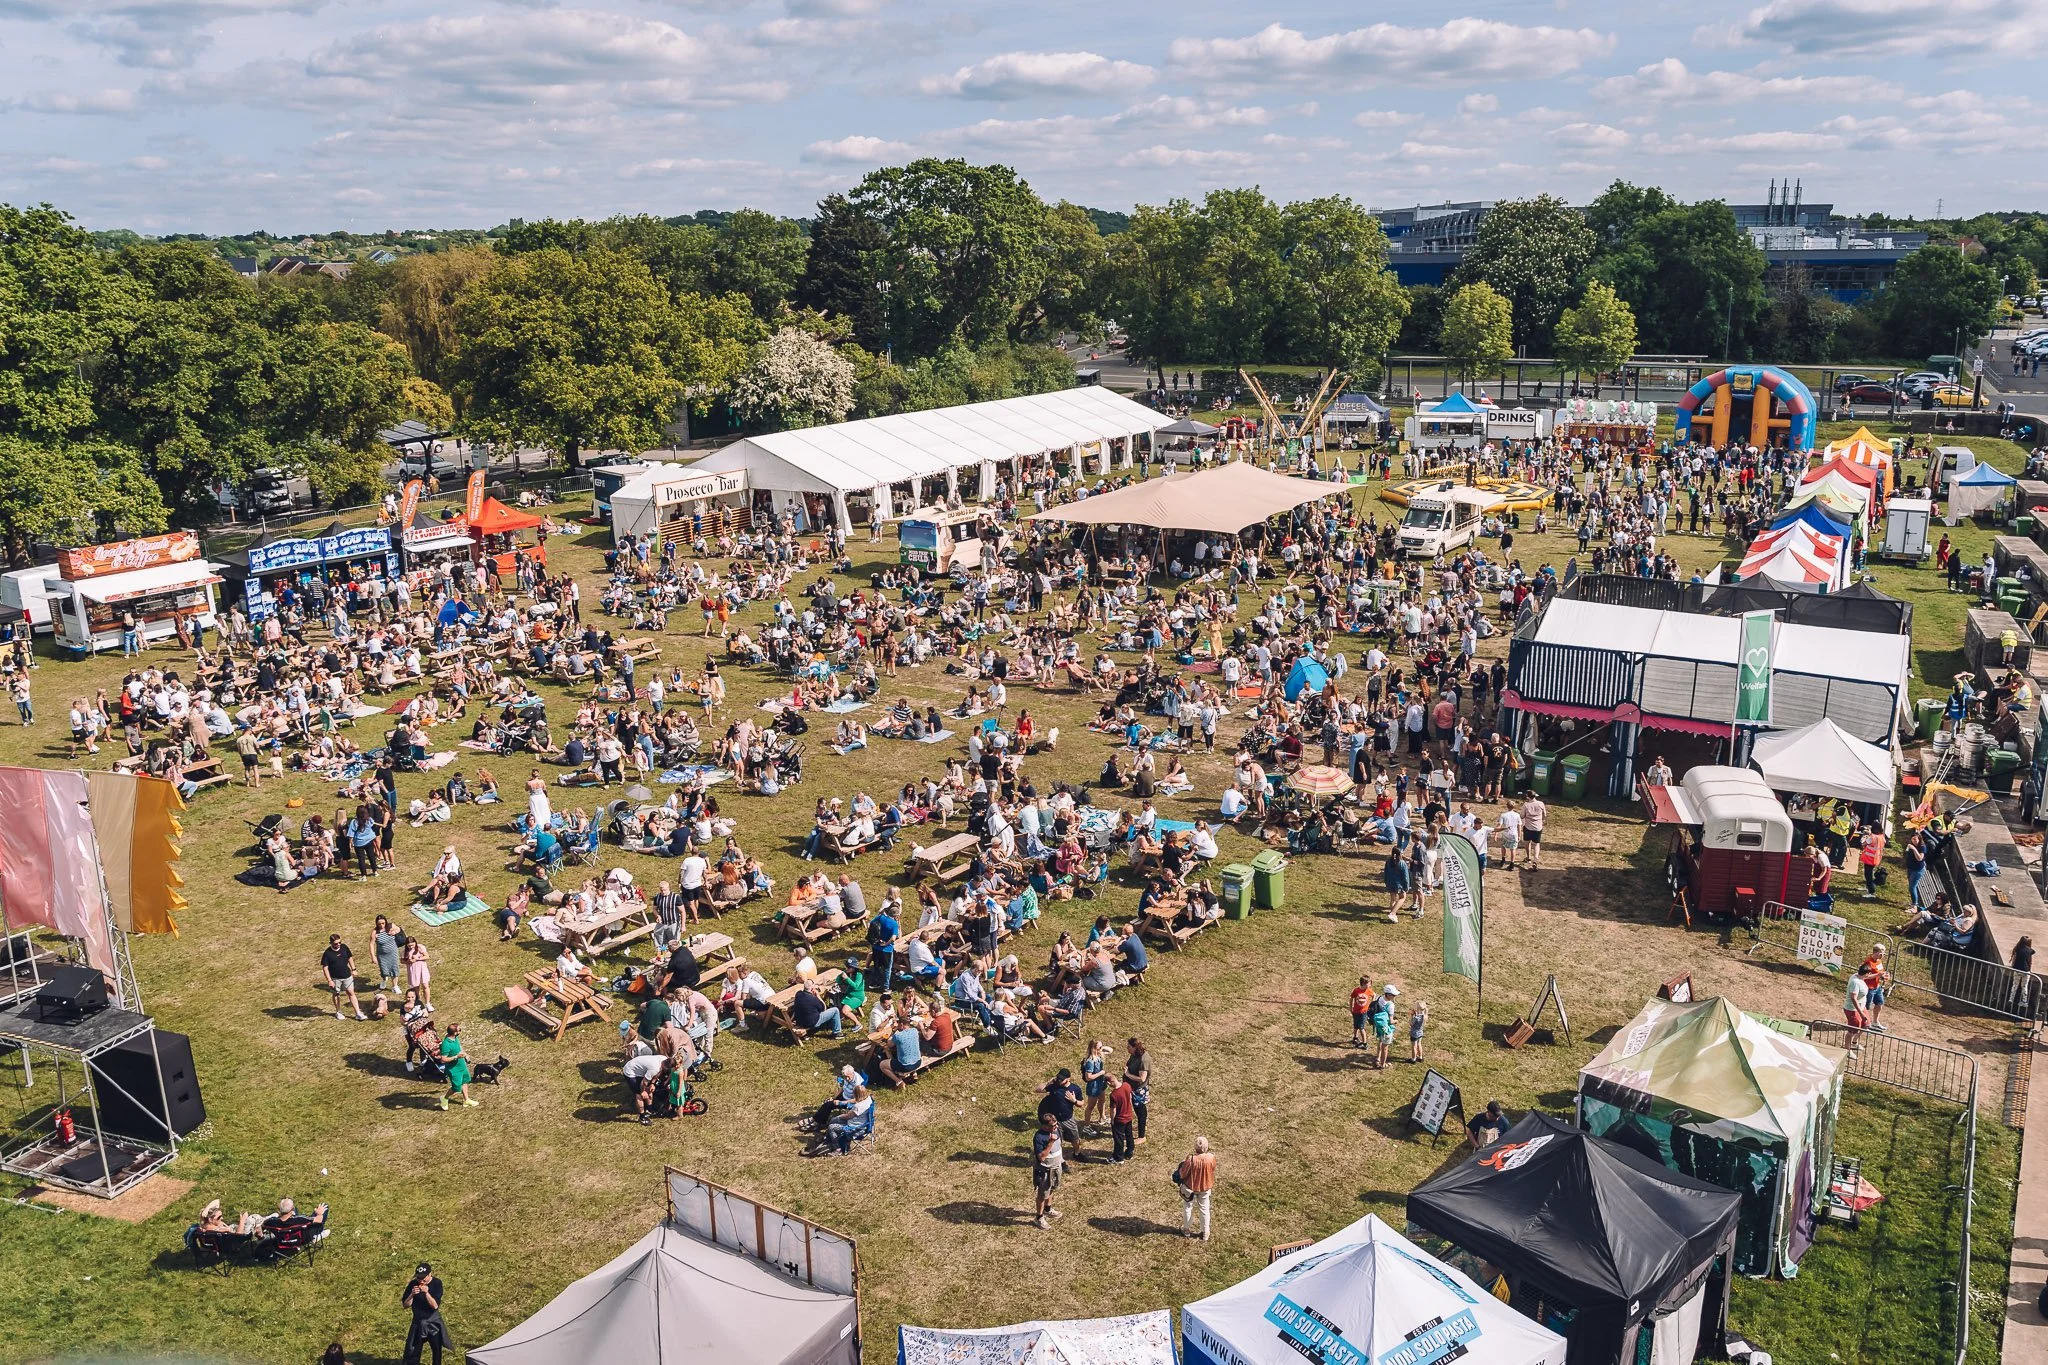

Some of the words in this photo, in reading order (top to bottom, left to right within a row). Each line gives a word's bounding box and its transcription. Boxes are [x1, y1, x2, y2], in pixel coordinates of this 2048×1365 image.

[1489, 413, 1534, 423] DRINKS
[666, 483, 713, 501] Prosecco
[325, 540, 339, 552] ICE
[340, 533, 363, 546] COLD
[364, 530, 388, 544] SLUSH
[95, 543, 134, 560] Loaded
[252, 552, 267, 565] ICE
[268, 545, 291, 558] COLD
[293, 542, 319, 556] SLUSH
[124, 553, 160, 568] Coffee
[1741, 682, 1768, 690] Welfare
[1803, 927, 1839, 943] SOUTH
[1800, 945, 1832, 960] SHOW
[1271, 1300, 1299, 1325] NON
[1295, 1316, 1325, 1343] SOLO
[1321, 1336, 1360, 1365] PASTA
[1414, 1329, 1443, 1358] SOLO
[1443, 1315, 1476, 1343] PASTA
[1289, 1339, 1311, 1357] ITALIA
